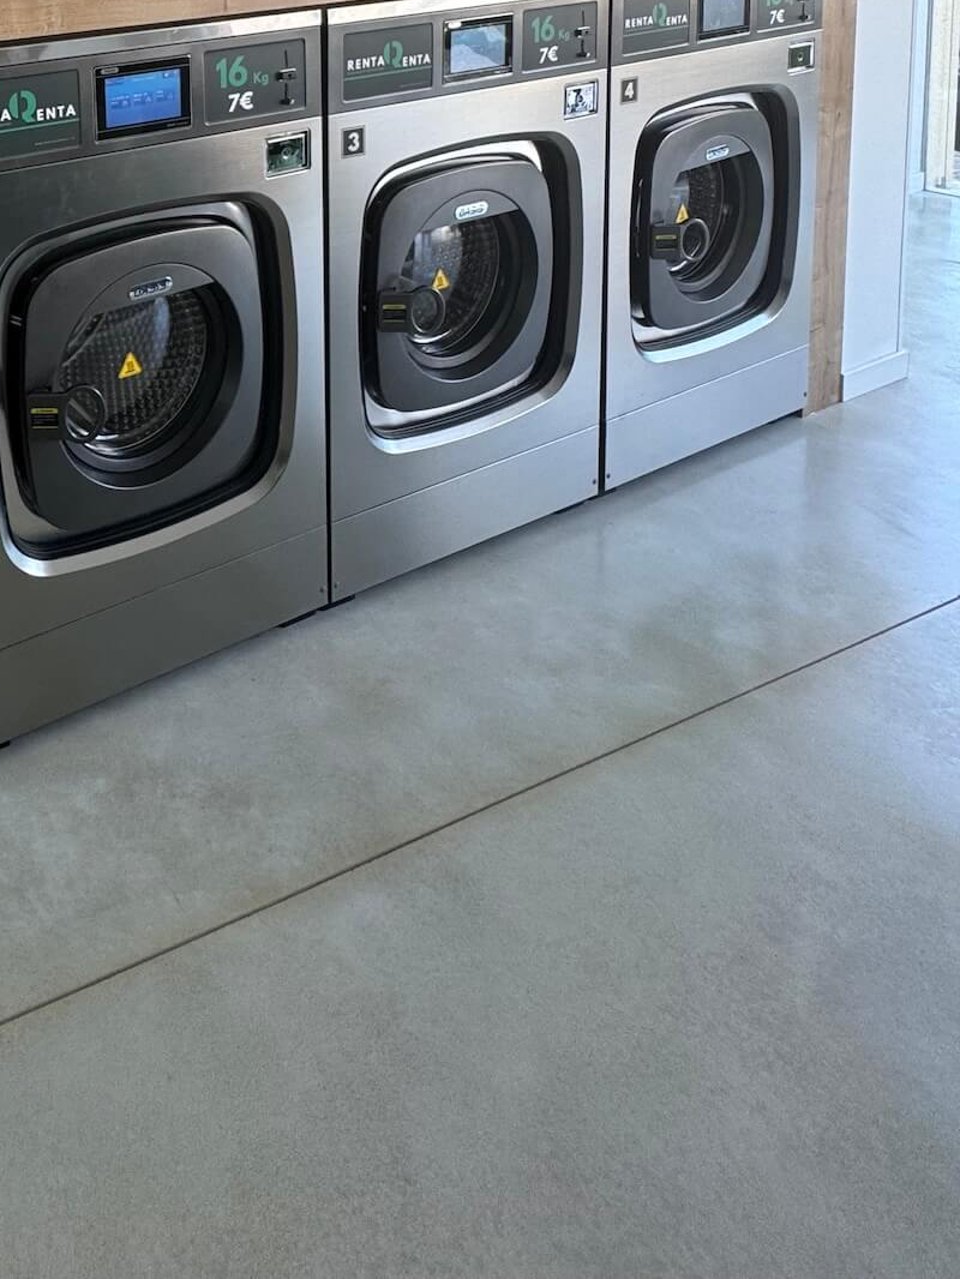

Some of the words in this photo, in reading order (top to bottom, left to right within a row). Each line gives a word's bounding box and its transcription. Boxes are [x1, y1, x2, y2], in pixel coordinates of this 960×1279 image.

[769, 9, 785, 25] 7€
[531, 15, 555, 43] 16
[539, 46, 558, 64] 7€
[216, 55, 247, 88] 16
[253, 72, 269, 86] Kg
[624, 82, 634, 99] 4
[228, 91, 254, 113] 7€
[347, 132, 360, 151] 3
